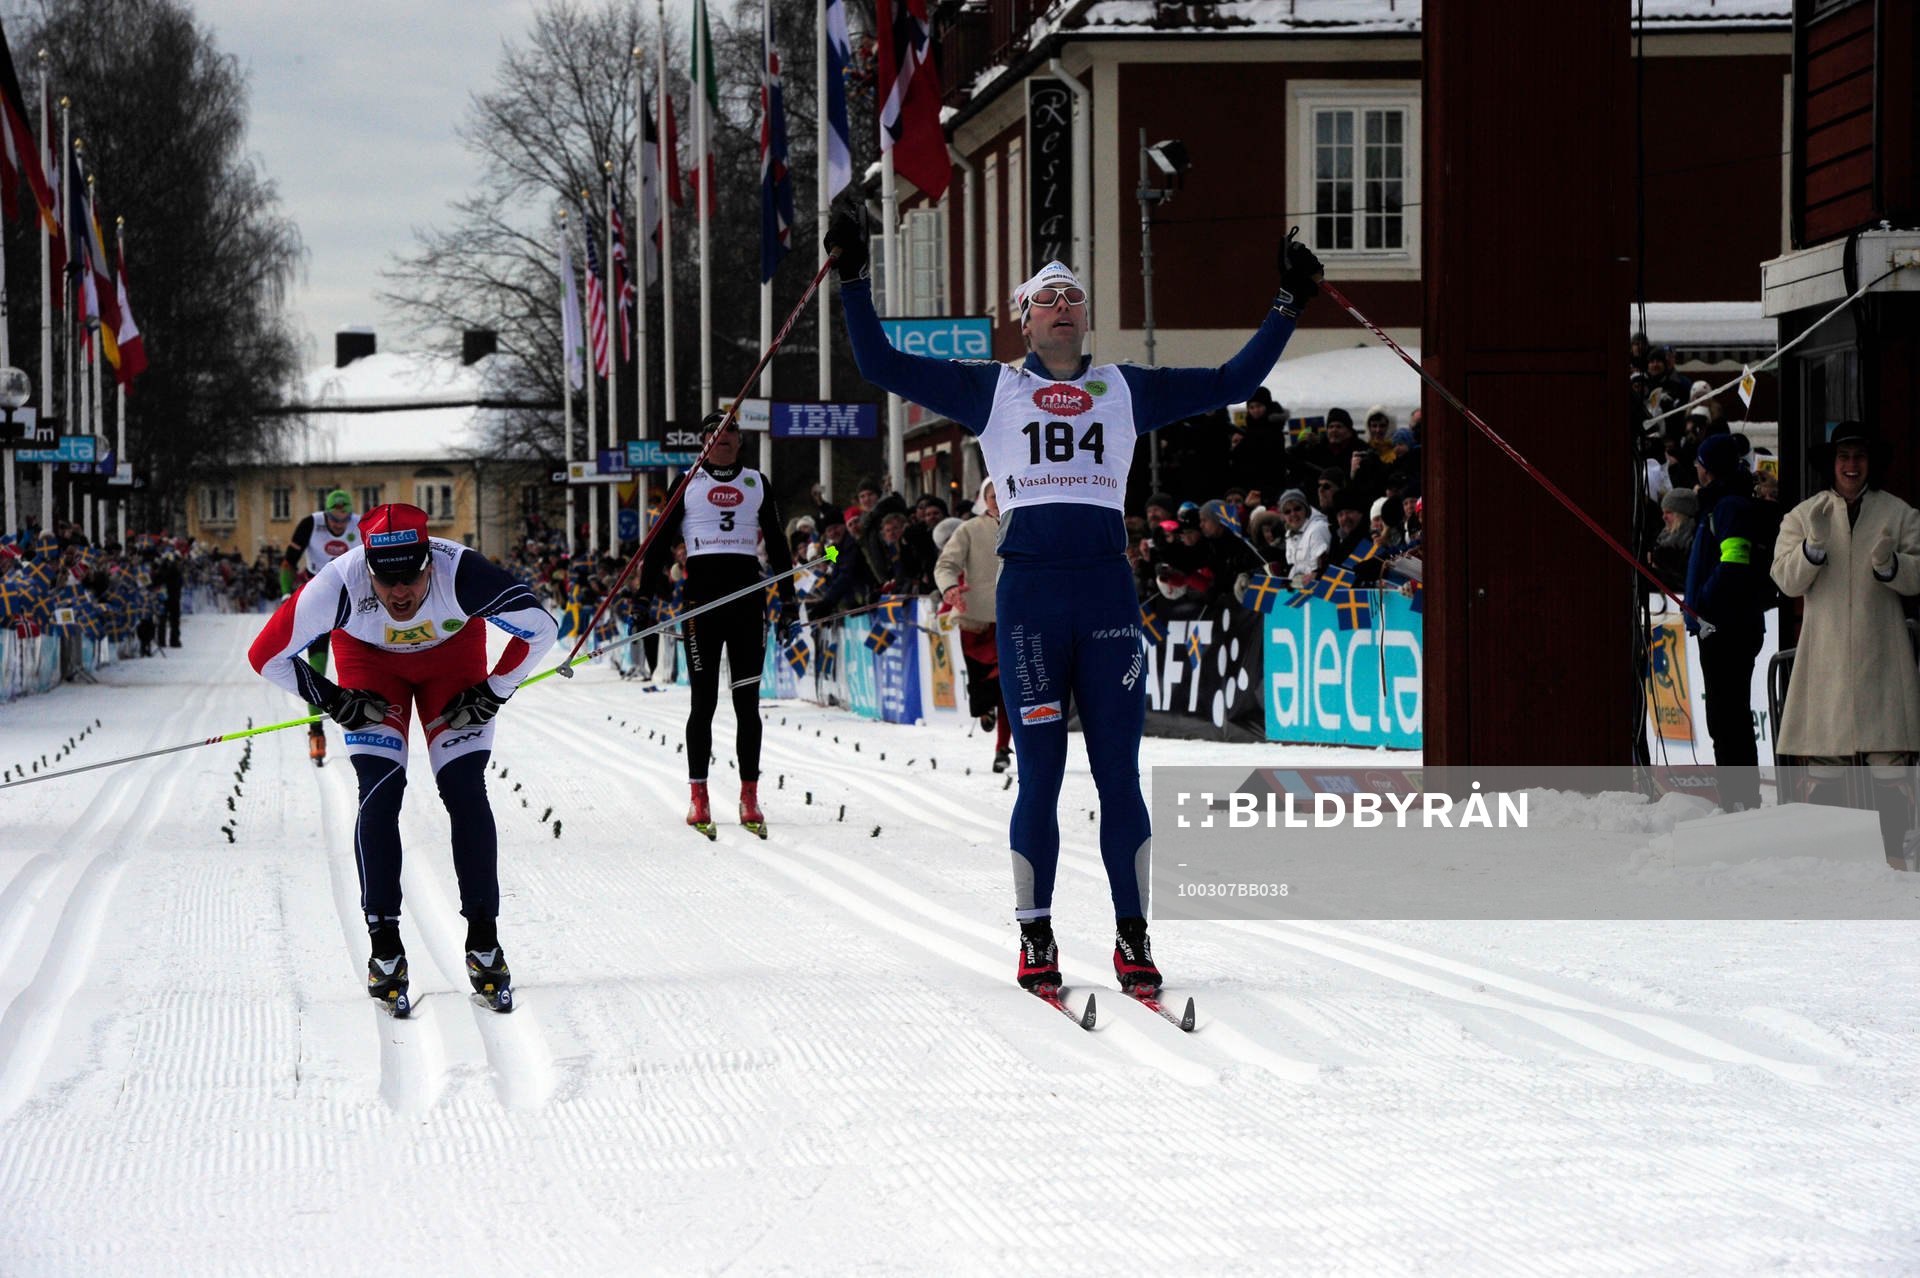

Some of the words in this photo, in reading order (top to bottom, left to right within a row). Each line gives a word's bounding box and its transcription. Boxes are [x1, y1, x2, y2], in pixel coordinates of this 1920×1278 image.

[1042, 391, 1083, 407] mix
[788, 404, 860, 435] IBM
[1021, 421, 1105, 465] 184
[713, 492, 738, 501] mix
[1019, 474, 1087, 487] Vasaloppet
[1092, 475, 1118, 488] 2010
[719, 511, 736, 531] 3
[1011, 624, 1036, 702] Hudiksvalls
[1026, 632, 1050, 692] Sparbank
[1272, 602, 1422, 735] alecta
